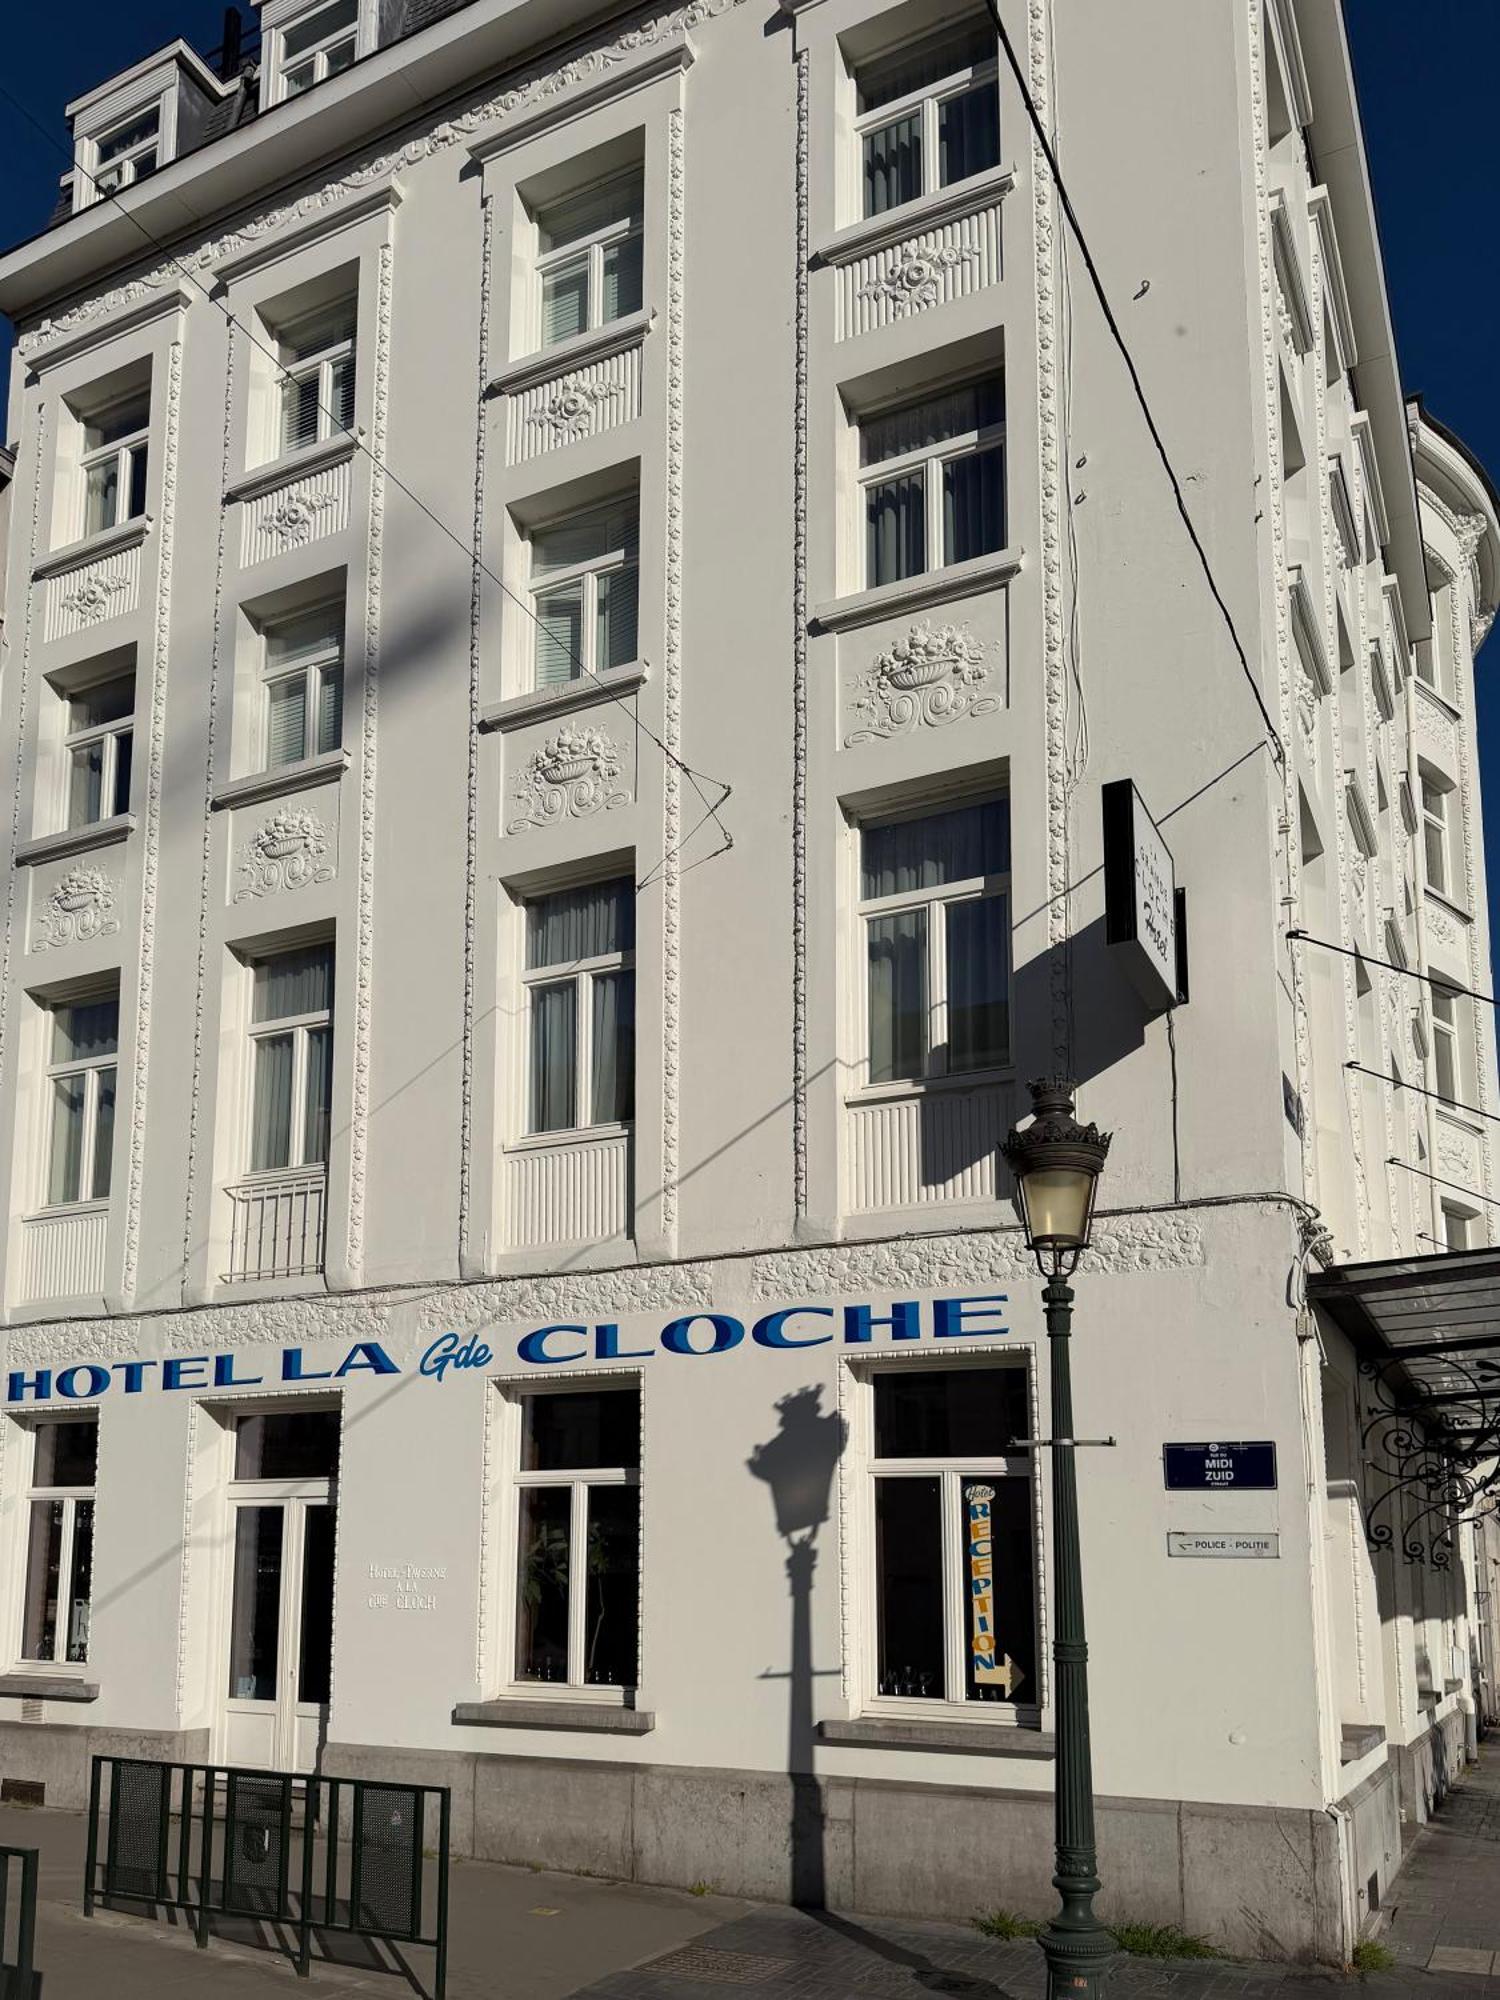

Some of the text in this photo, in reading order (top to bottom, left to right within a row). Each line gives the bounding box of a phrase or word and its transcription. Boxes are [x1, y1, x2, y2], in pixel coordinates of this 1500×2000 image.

[1135, 858, 1175, 936] CLOCHE
[8, 1294, 1011, 1400] HOTEL LA Gde CLOCHE
[1205, 1459, 1233, 1469] MIDI
[1205, 1471, 1234, 1481] ZUID
[1195, 1541, 1226, 1549] POLICE
[1235, 1541, 1269, 1549] POLITIE
[969, 1503, 996, 1670] RECEPTION
